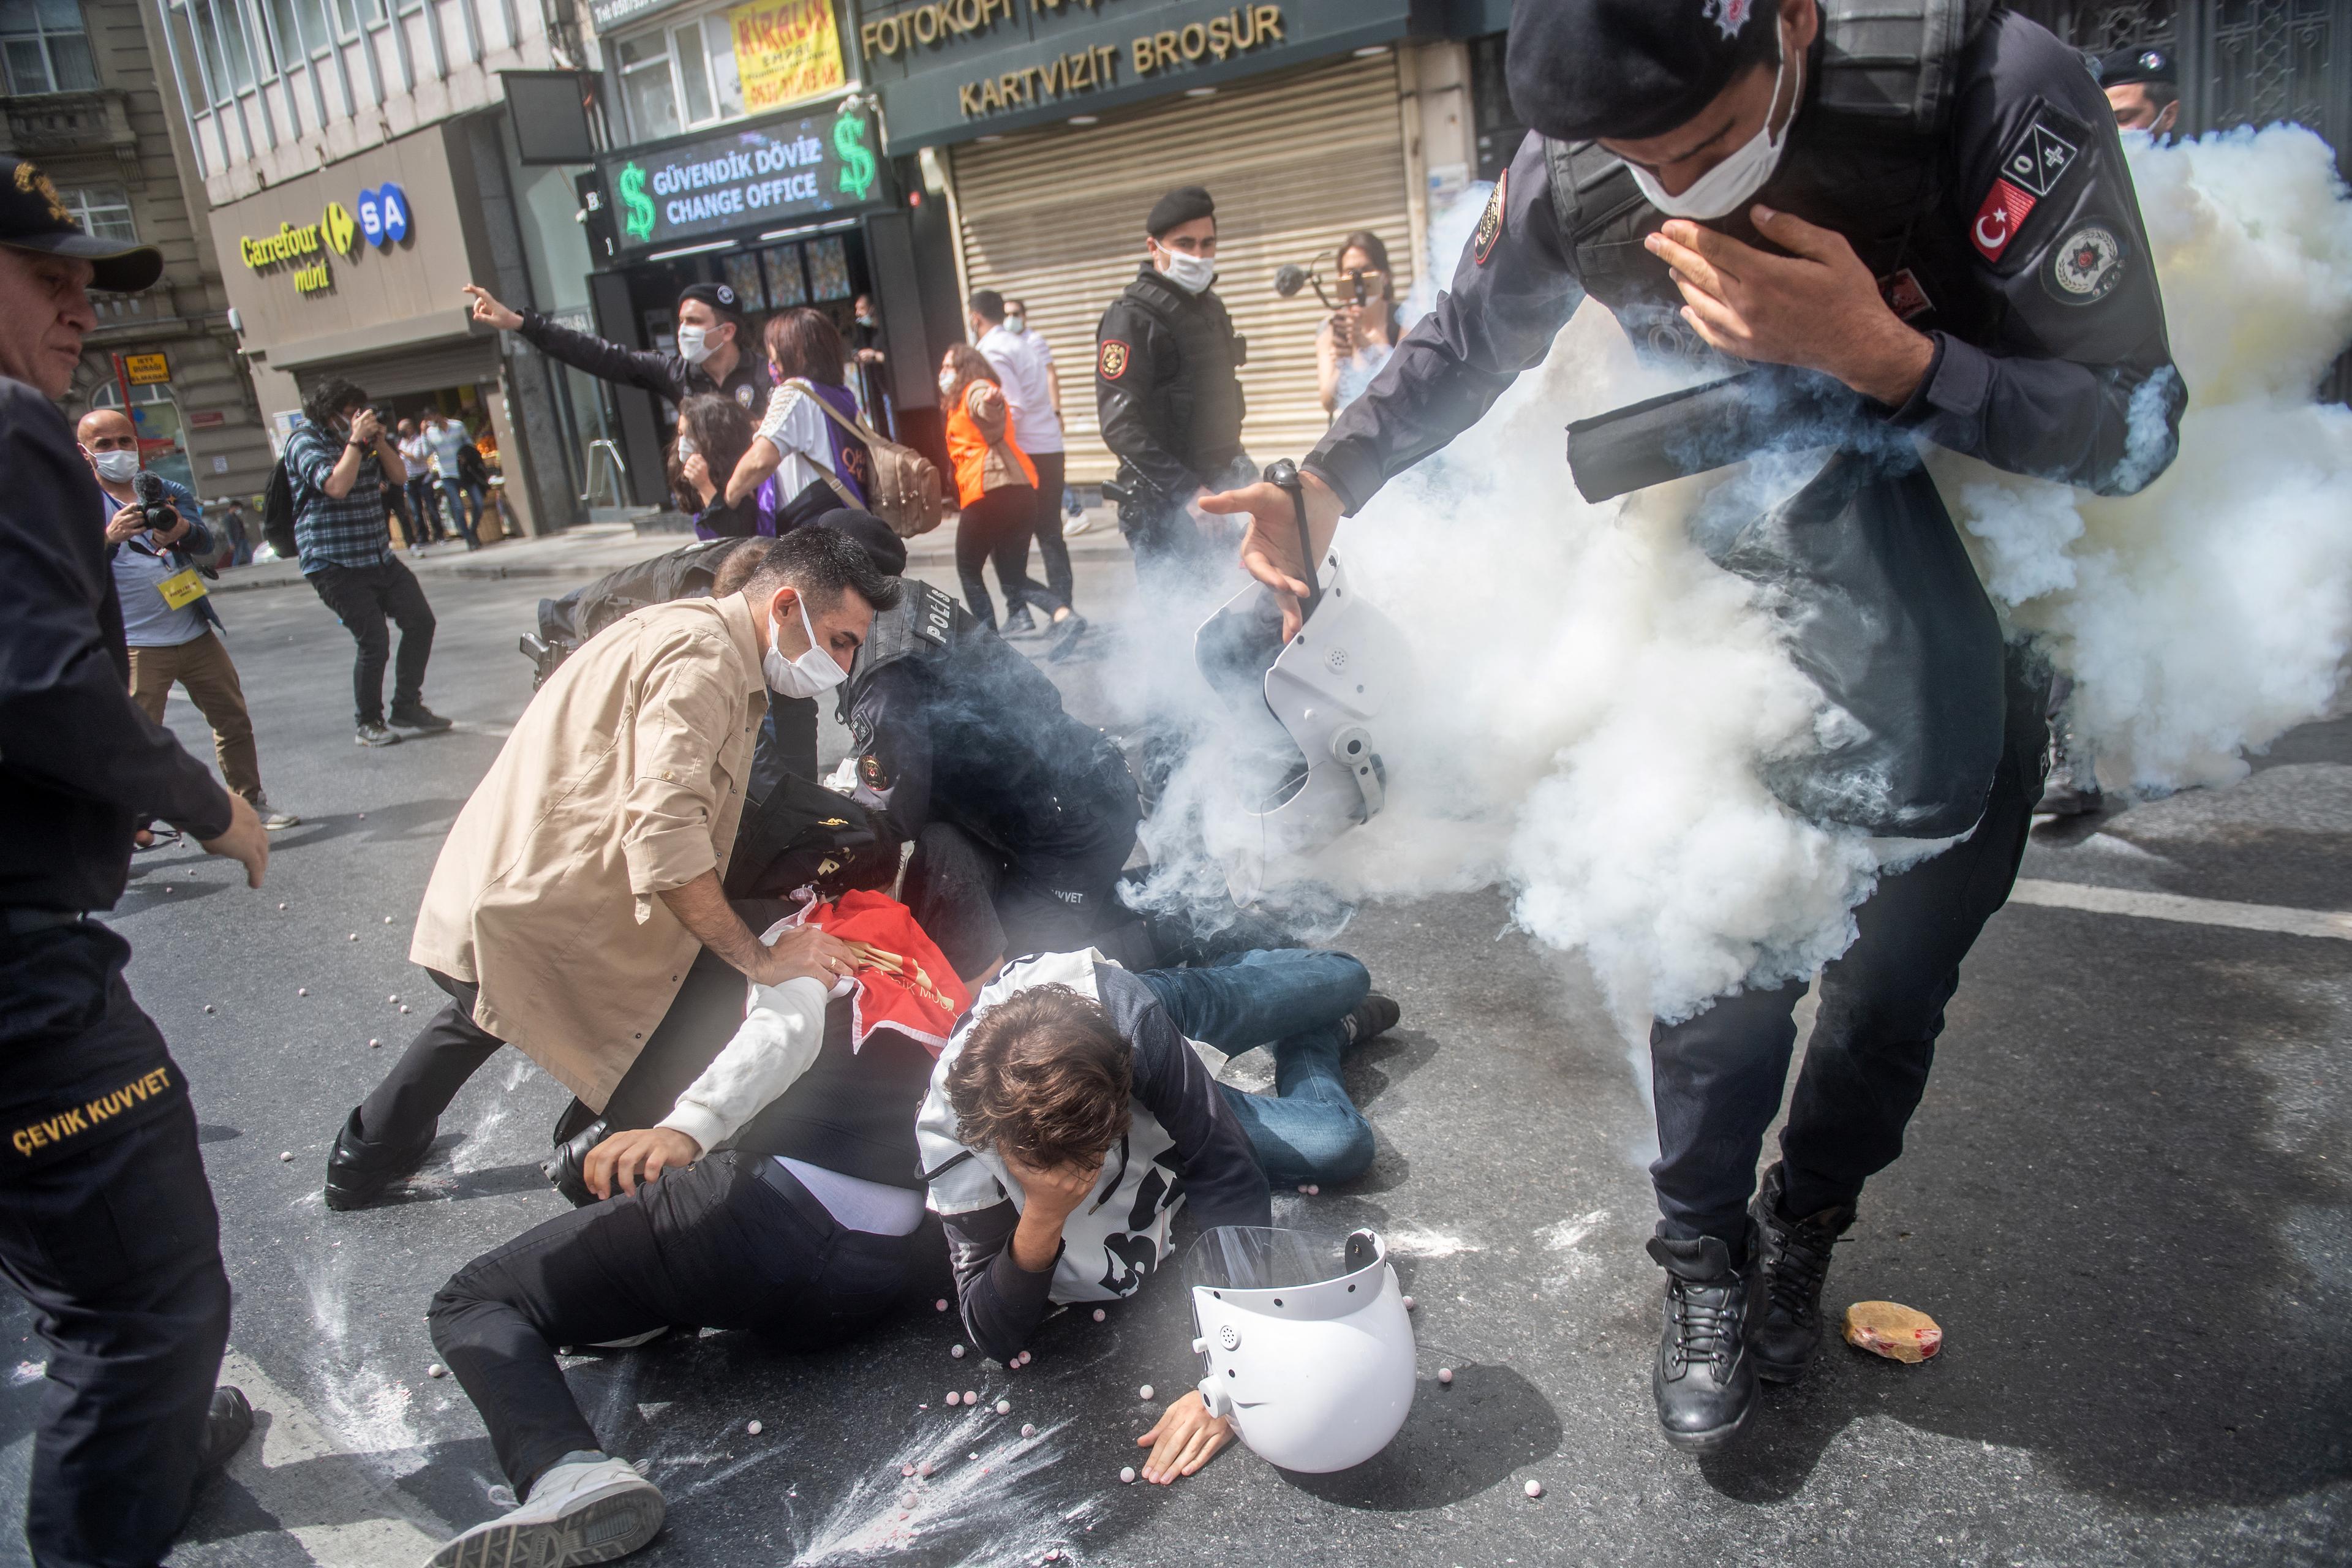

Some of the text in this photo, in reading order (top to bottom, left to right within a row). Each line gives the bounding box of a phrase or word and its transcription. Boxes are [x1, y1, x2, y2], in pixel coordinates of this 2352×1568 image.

[959, 3, 1283, 116] KARTVİZİT BROŞÜR
[652, 135, 823, 197] GÜVENDİK DÖVİZ
[666, 173, 819, 225] CHANGE OFFICE
[240, 195, 405, 269] Carrefour SA
[294, 257, 329, 294] mini
[926, 589, 951, 644] POLİS
[12, 1067, 171, 1158] ÇEVİK KUVVET
